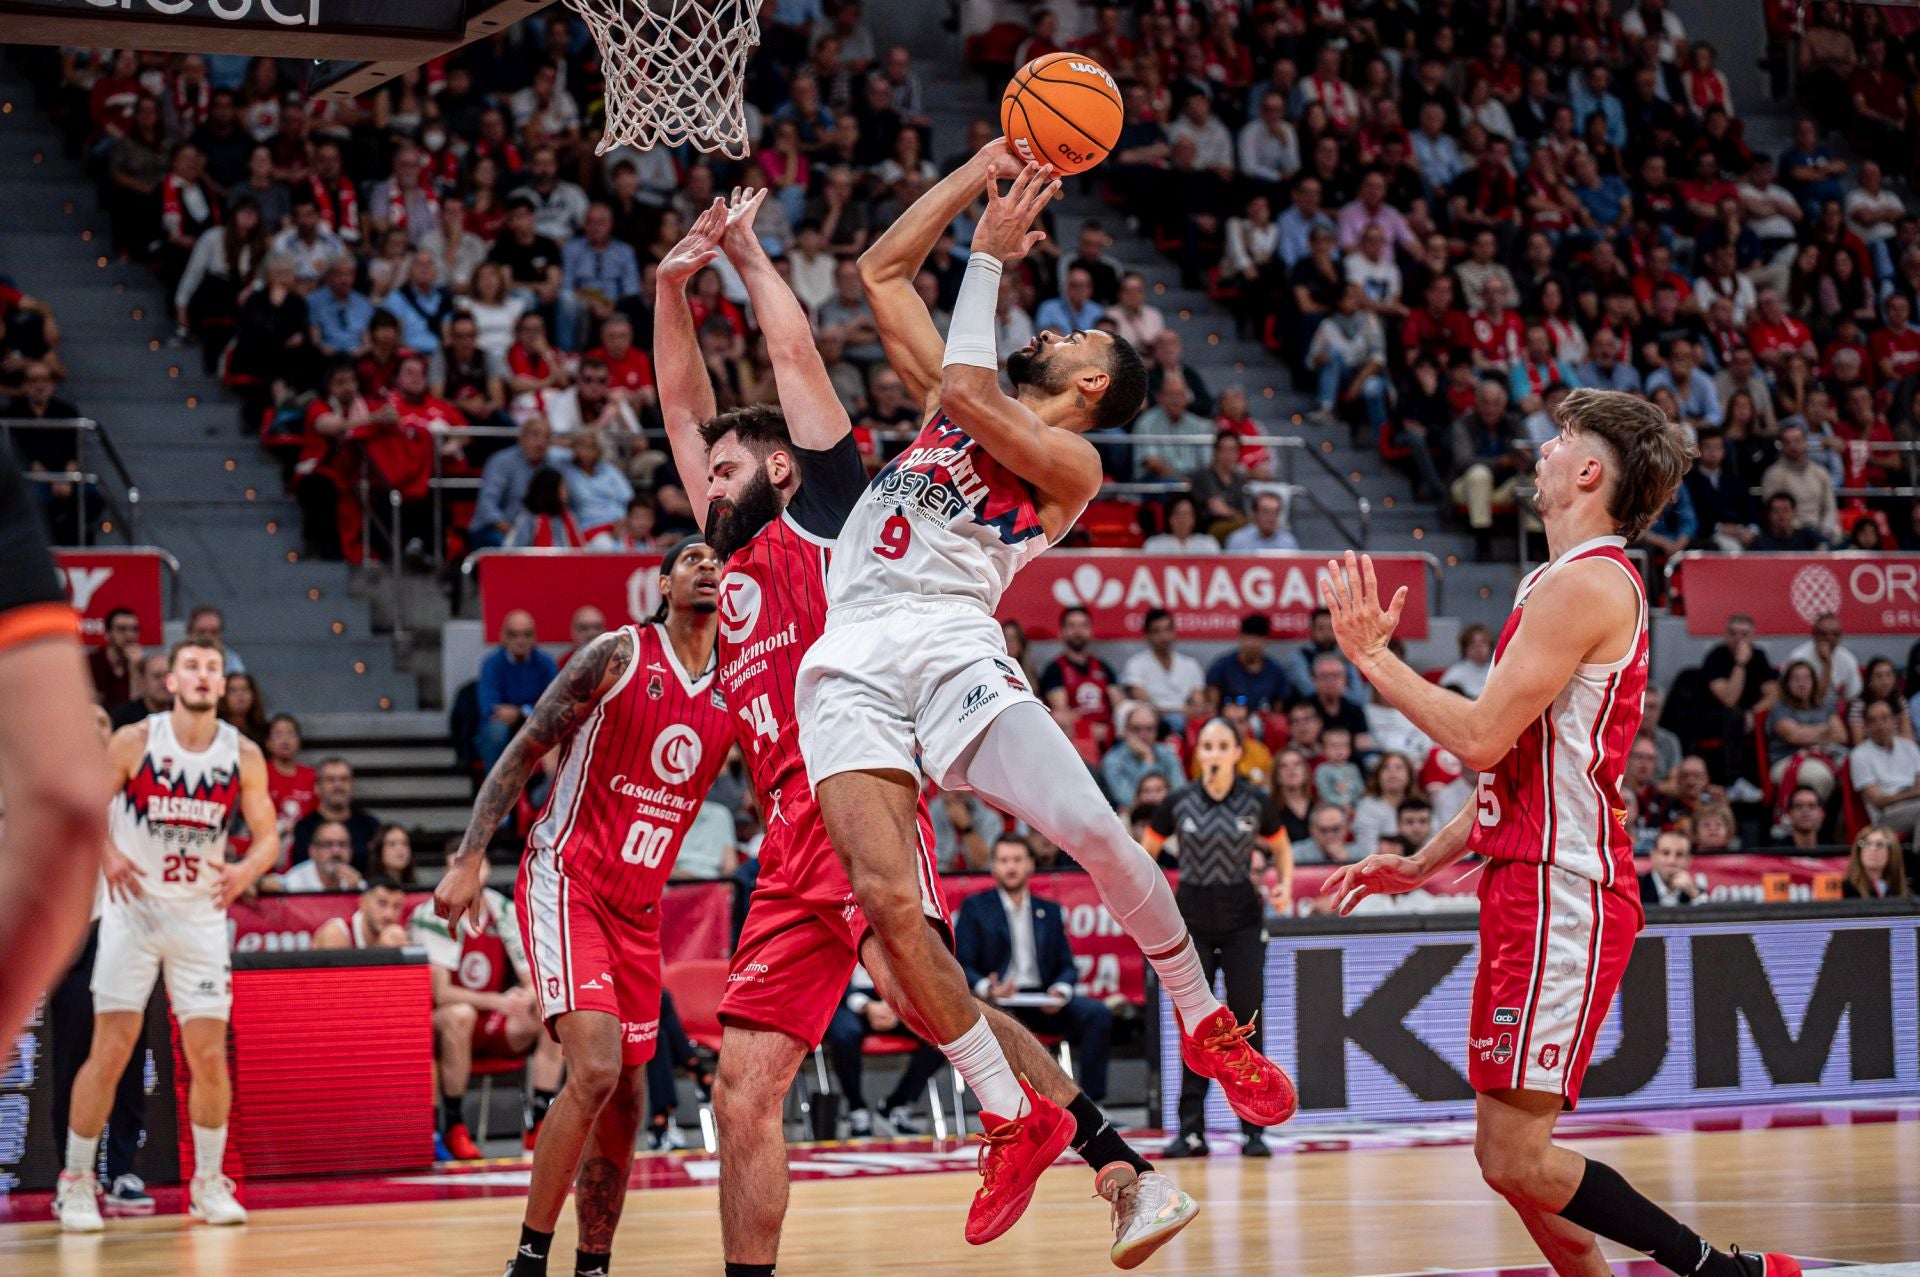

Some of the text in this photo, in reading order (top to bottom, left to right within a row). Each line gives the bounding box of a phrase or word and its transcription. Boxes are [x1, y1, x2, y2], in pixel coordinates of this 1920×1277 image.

[1058, 143, 1084, 165] acb
[880, 471, 961, 516] osner
[873, 514, 911, 560] 9
[1849, 563, 1920, 604] OR
[719, 622, 799, 685] Csademont
[958, 691, 999, 723] HYUNDAI
[609, 774, 697, 812] Casademt
[637, 803, 680, 823] ZARAGOZA
[621, 820, 673, 869] 00
[163, 854, 200, 882] 25
[1495, 1014, 1513, 1022] acb
